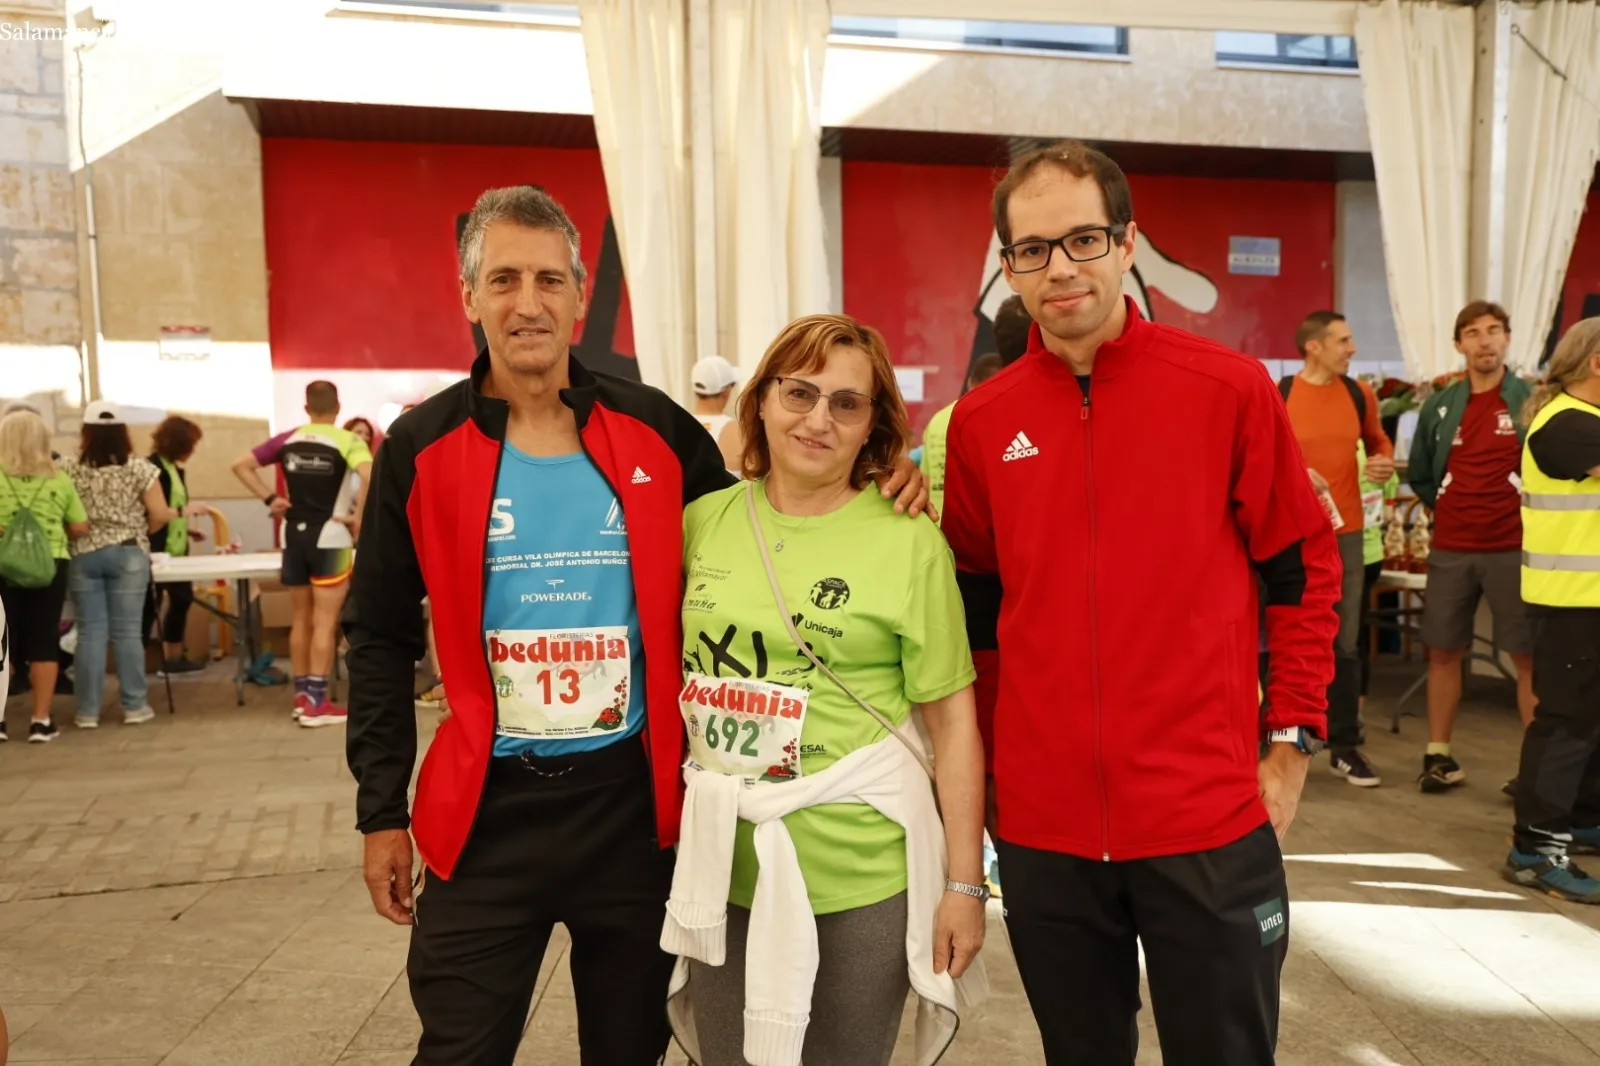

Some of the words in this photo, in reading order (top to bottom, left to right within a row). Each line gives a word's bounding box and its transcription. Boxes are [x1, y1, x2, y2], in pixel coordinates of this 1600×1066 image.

[1002, 446, 1039, 462] adidas
[496, 555, 523, 563] CURSA
[566, 558, 601, 566] ANTONIO
[804, 619, 843, 639] Unicaja
[489, 633, 627, 664] bedunia
[536, 669, 581, 705] 13
[681, 678, 803, 720] bedunia
[705, 714, 760, 757] 692
